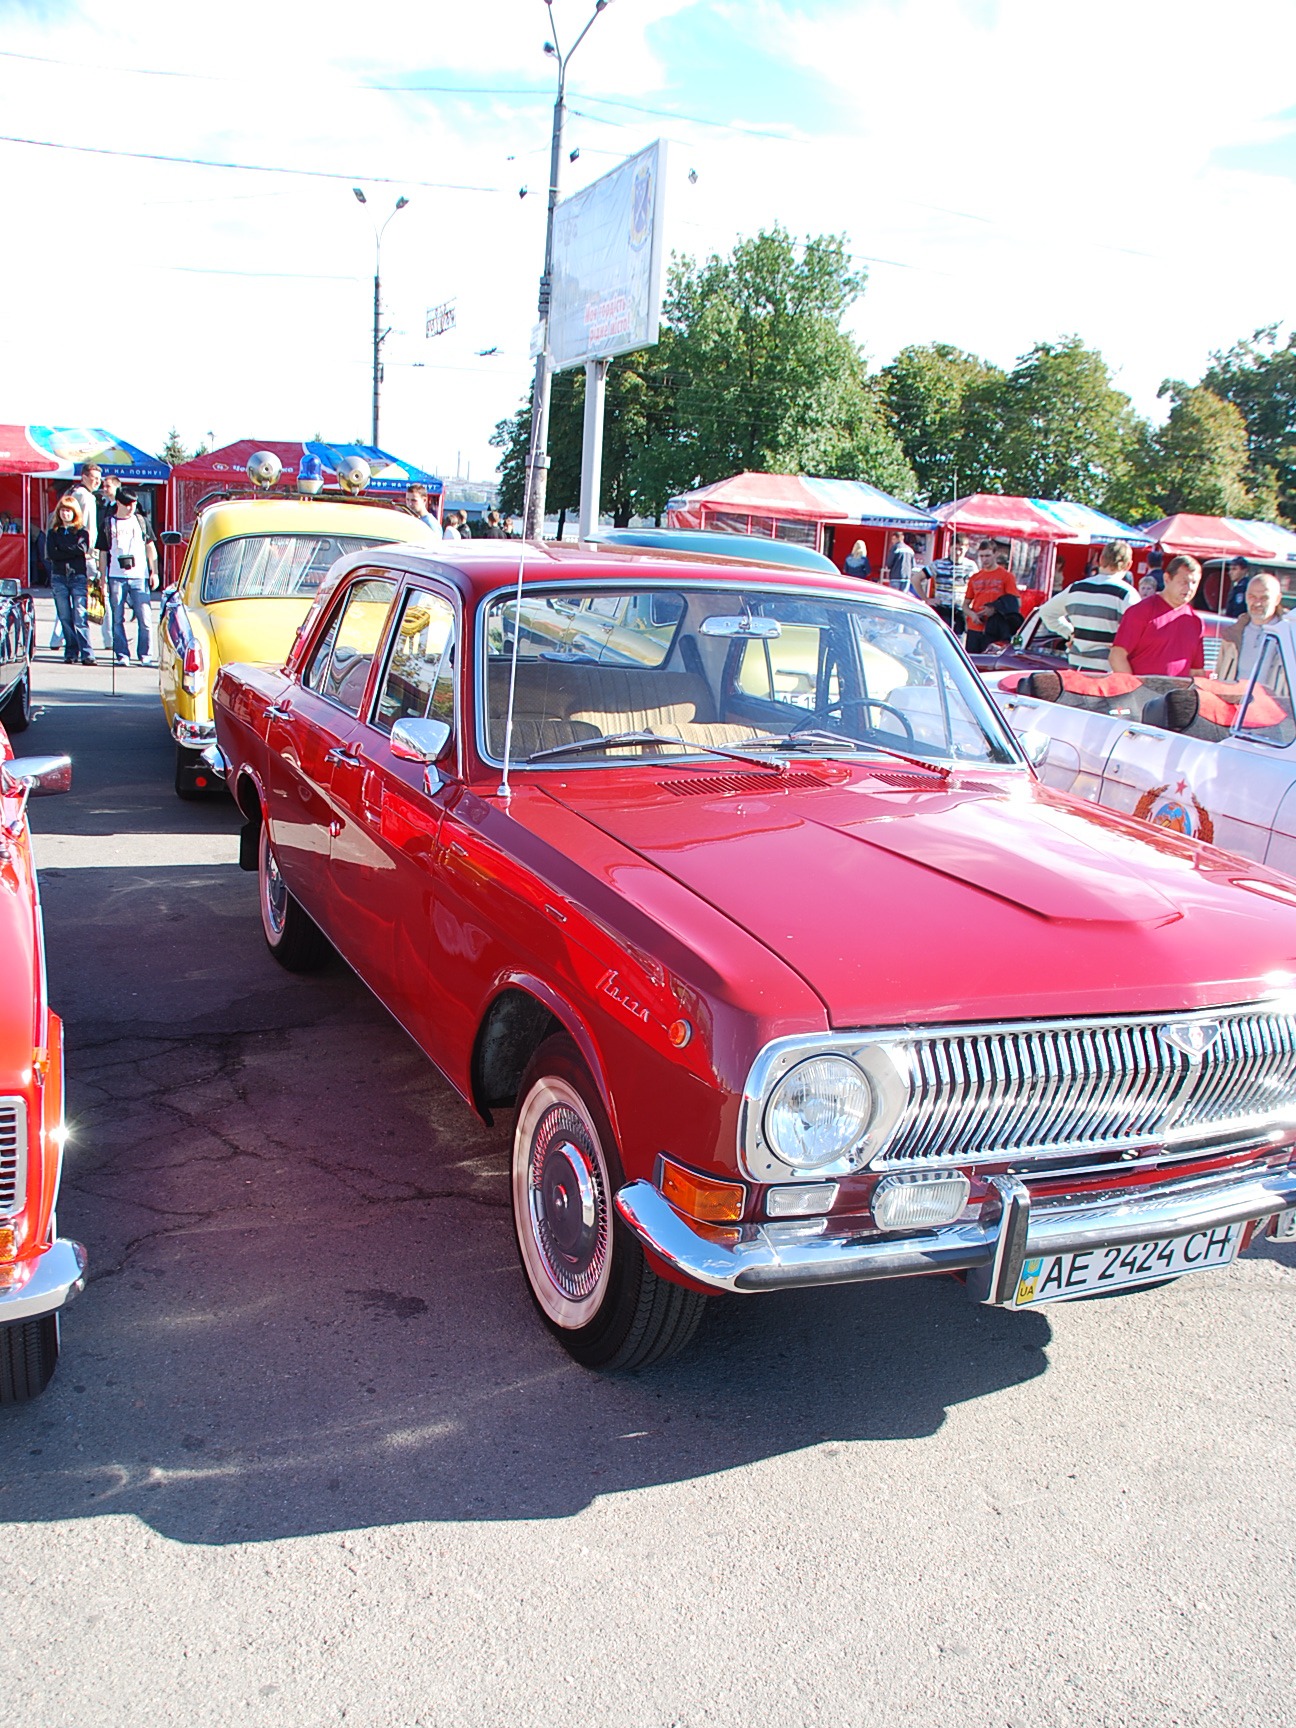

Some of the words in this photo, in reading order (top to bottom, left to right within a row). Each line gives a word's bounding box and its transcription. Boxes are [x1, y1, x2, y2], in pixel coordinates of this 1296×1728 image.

[1039, 1251, 1095, 1293] AE
[1097, 1239, 1176, 1281] 2424
[1183, 1225, 1232, 1263] CH
[1019, 1285, 1035, 1297] UA
